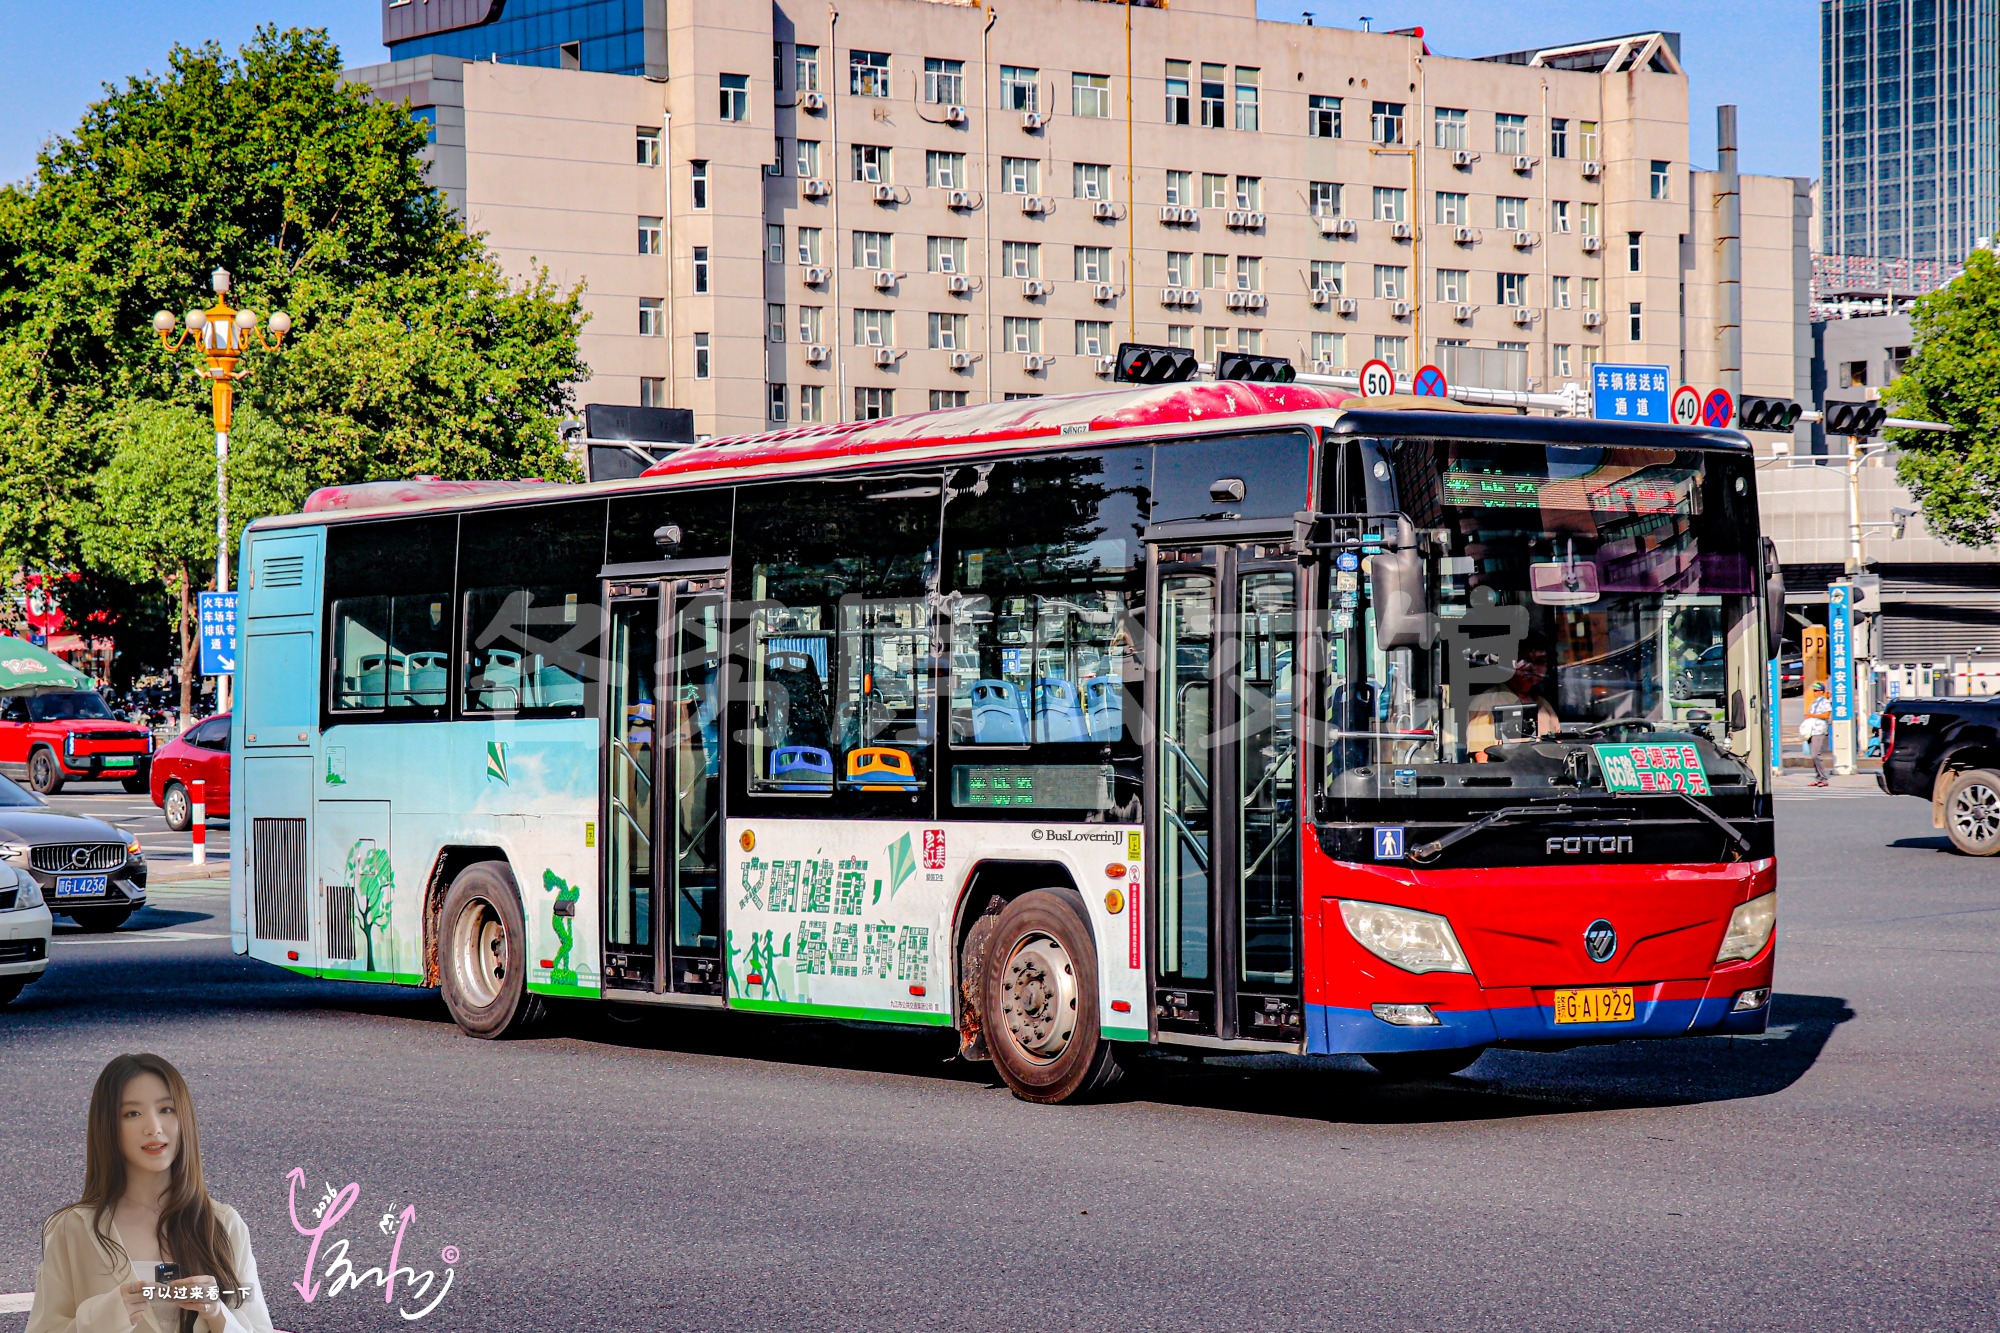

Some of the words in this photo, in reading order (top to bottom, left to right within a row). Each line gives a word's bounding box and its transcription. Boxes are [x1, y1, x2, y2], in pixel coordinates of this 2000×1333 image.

[1368, 373, 1387, 396] 50
[1597, 371, 1665, 392] 车辆接送站
[1615, 397, 1649, 416] 通道
[1677, 398, 1695, 419] 40
[1339, 581, 1356, 589] 2020
[203, 597, 238, 609] 火车站
[203, 611, 237, 623] 车场车
[1805, 637, 1813, 653] P
[1817, 637, 1824, 653] P
[1833, 617, 1846, 669] 各行其道
[1834, 671, 1847, 717] 安全可靠
[1629, 746, 1700, 769] 空调开启
[1605, 754, 1639, 787] 66路
[1638, 771, 1708, 795] 票价2元
[1546, 836, 1633, 855] FOTON
